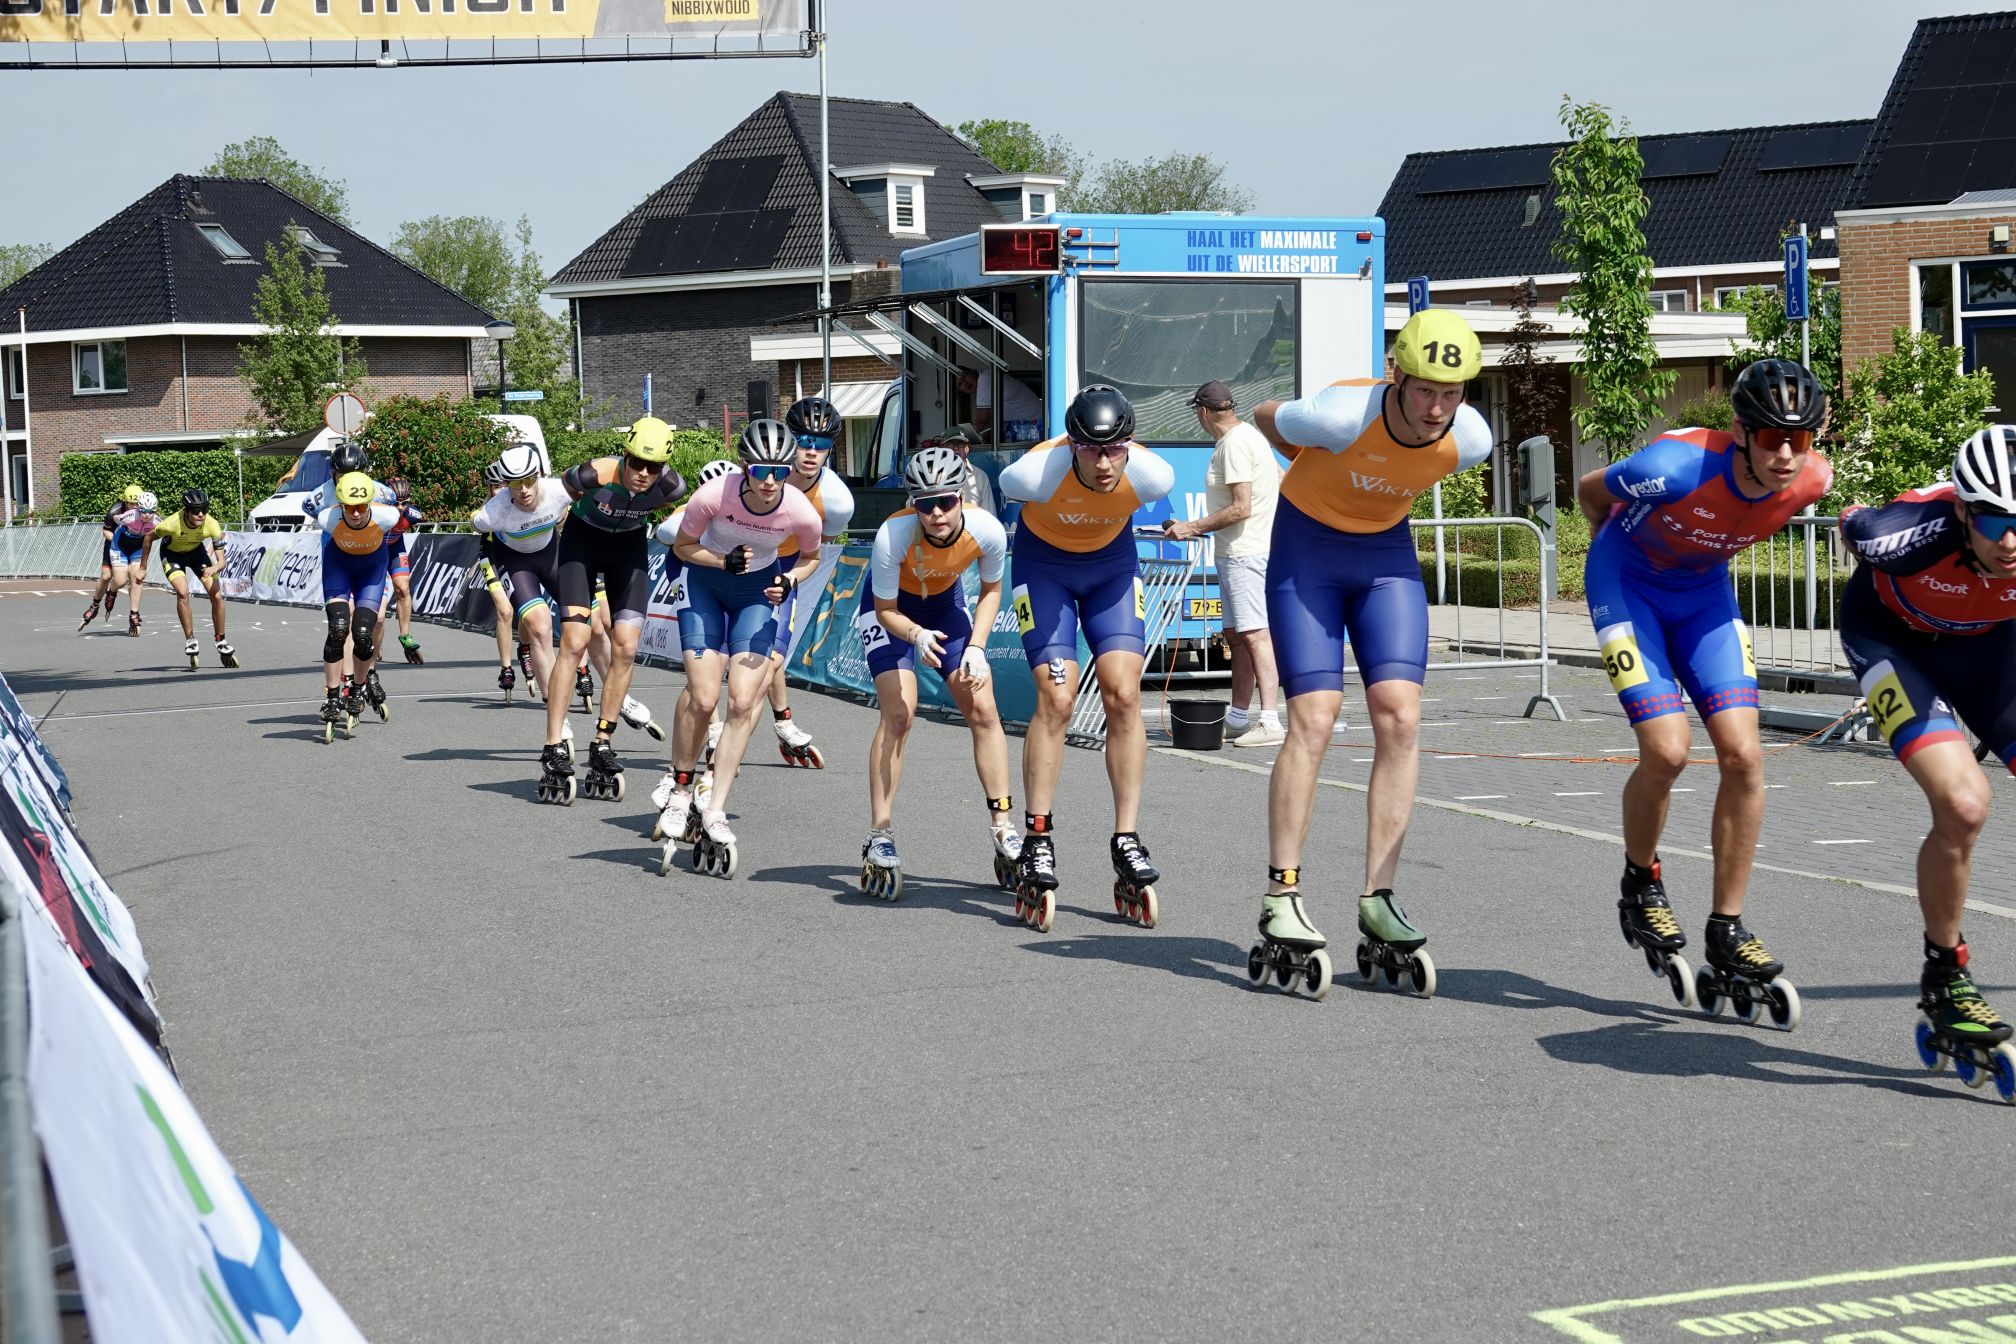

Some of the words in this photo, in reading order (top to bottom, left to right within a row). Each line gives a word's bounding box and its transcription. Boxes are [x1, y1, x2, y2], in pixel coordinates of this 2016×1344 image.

[671, 0, 750, 15] NIBBIXWOUD
[1014, 231, 1054, 267] 42
[1187, 230, 1224, 248] HAAL
[1230, 231, 1256, 248] HET
[1260, 231, 1337, 249] MAXIMALE
[1187, 254, 1211, 272] UIT
[1215, 254, 1233, 272] DE
[1237, 254, 1338, 273] WIELERSPORT
[1789, 244, 1799, 284] P
[1423, 341, 1462, 368] 18
[349, 486, 368, 498] 23
[1618, 475, 1666, 498] Vector
[1692, 528, 1728, 540] Port
[1737, 534, 1757, 542] of
[1855, 516, 1949, 557] MATTER
[1881, 545, 1912, 561] YOUR
[1914, 534, 1939, 548] BEST
[861, 625, 885, 646] 52
[1604, 649, 1634, 678] 50
[1872, 688, 1903, 726] 42
